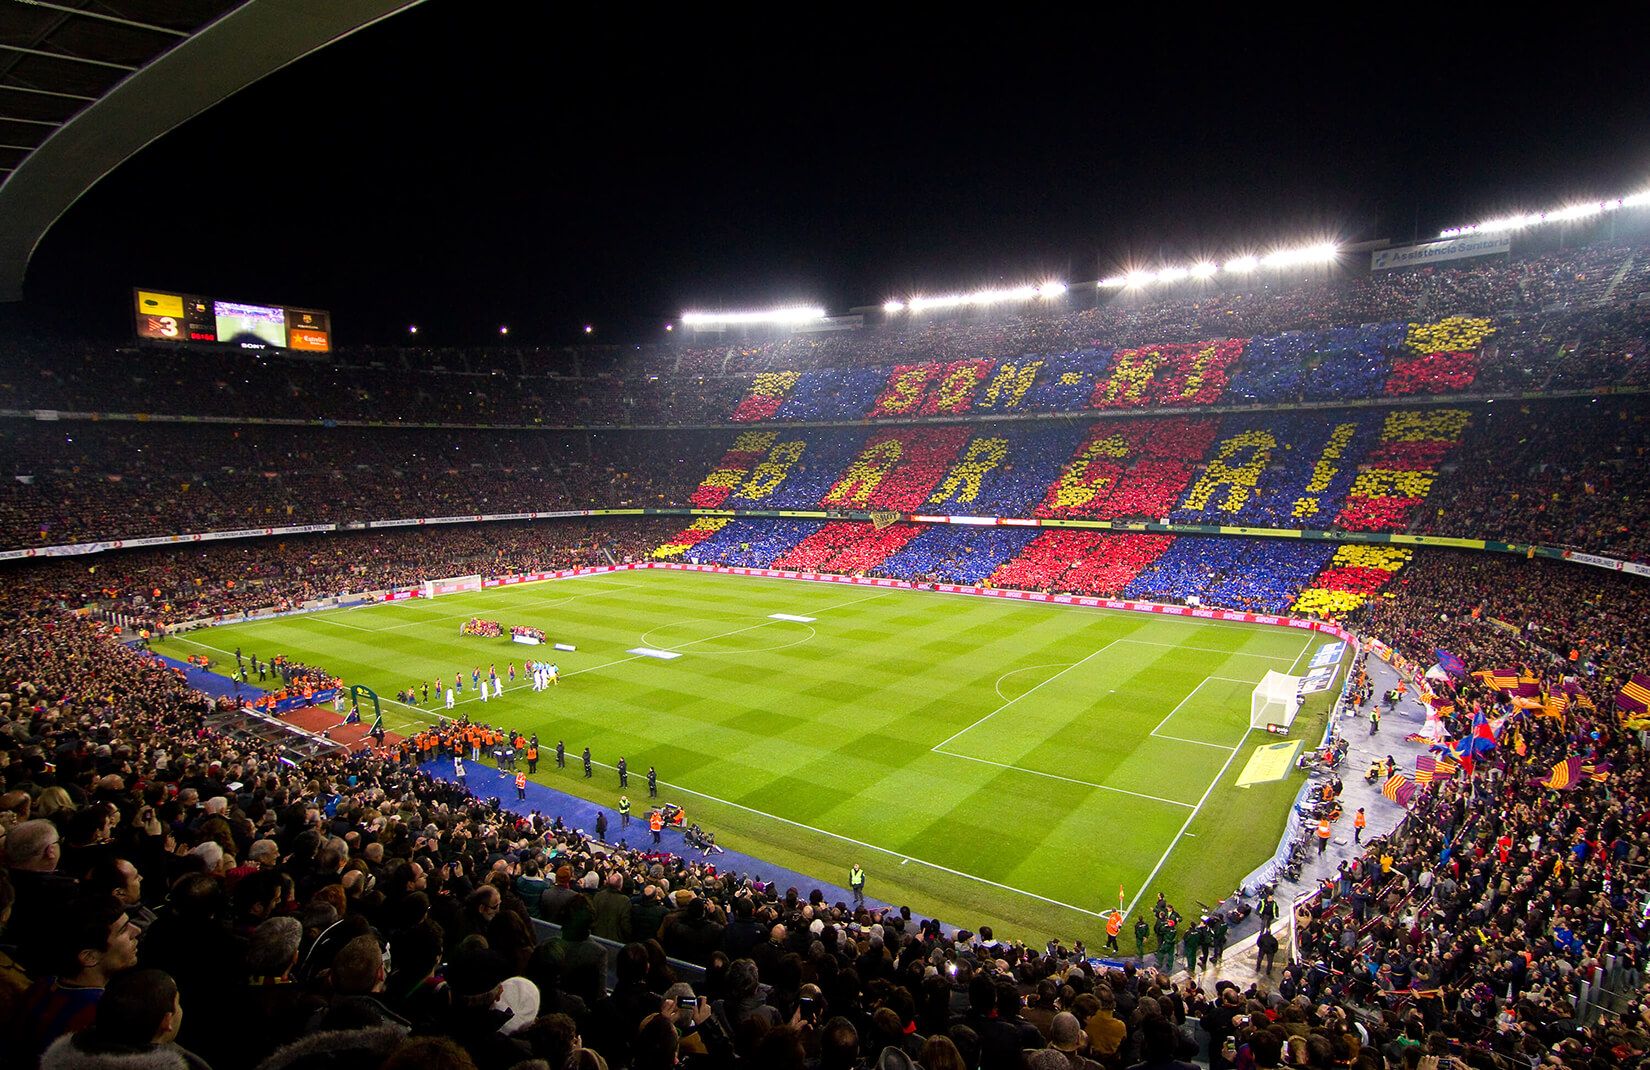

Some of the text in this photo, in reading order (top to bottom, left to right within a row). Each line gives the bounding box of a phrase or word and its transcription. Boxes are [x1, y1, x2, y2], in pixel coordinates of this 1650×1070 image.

[159, 316, 179, 337] 3
[241, 342, 266, 350] SONY
[1079, 598, 1097, 606] SPORT
[1134, 603, 1153, 611] SPORT
[1163, 606, 1183, 614] SPORT
[1192, 609, 1213, 617] SPORT
[1223, 612, 1245, 620] SPORT
[1255, 615, 1278, 624] SPORT
[1289, 619, 1311, 628] SPORT
